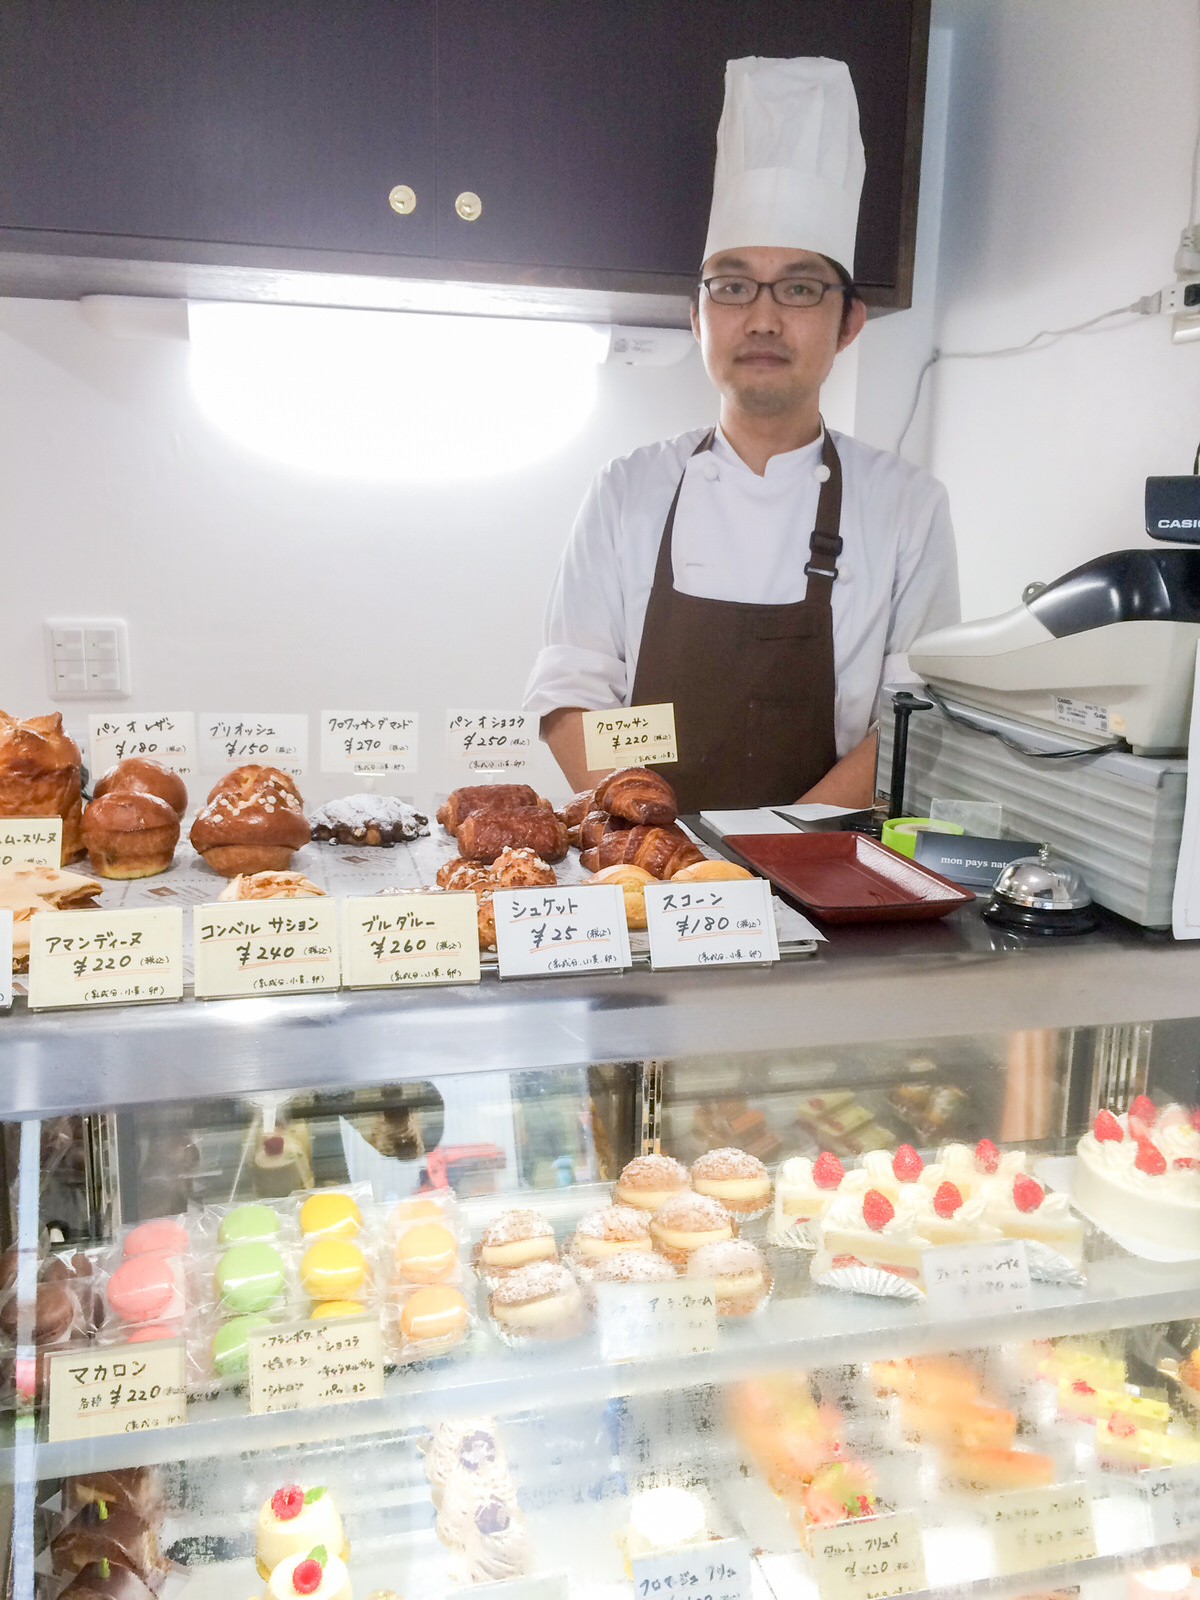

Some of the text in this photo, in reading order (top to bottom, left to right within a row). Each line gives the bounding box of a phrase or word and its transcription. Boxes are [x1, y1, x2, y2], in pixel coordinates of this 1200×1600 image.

[209, 721, 277, 737] ブリオッシュ
[596, 717, 649, 735] クロワッサン
[940, 856, 963, 866] mon
[964, 857, 989, 869] pays
[511, 897, 578, 919] シュケット
[662, 892, 724, 911] スコーン
[361, 911, 436, 933] ブルダルー
[675, 914, 730, 937] ¥180
[45, 931, 144, 953] アマンディーヌ
[530, 923, 578, 949] ¥25
[236, 941, 295, 966] ¥240
[370, 936, 427, 959] ¥260
[73, 954, 132, 978] ¥220
[68, 1360, 147, 1385] マカロン
